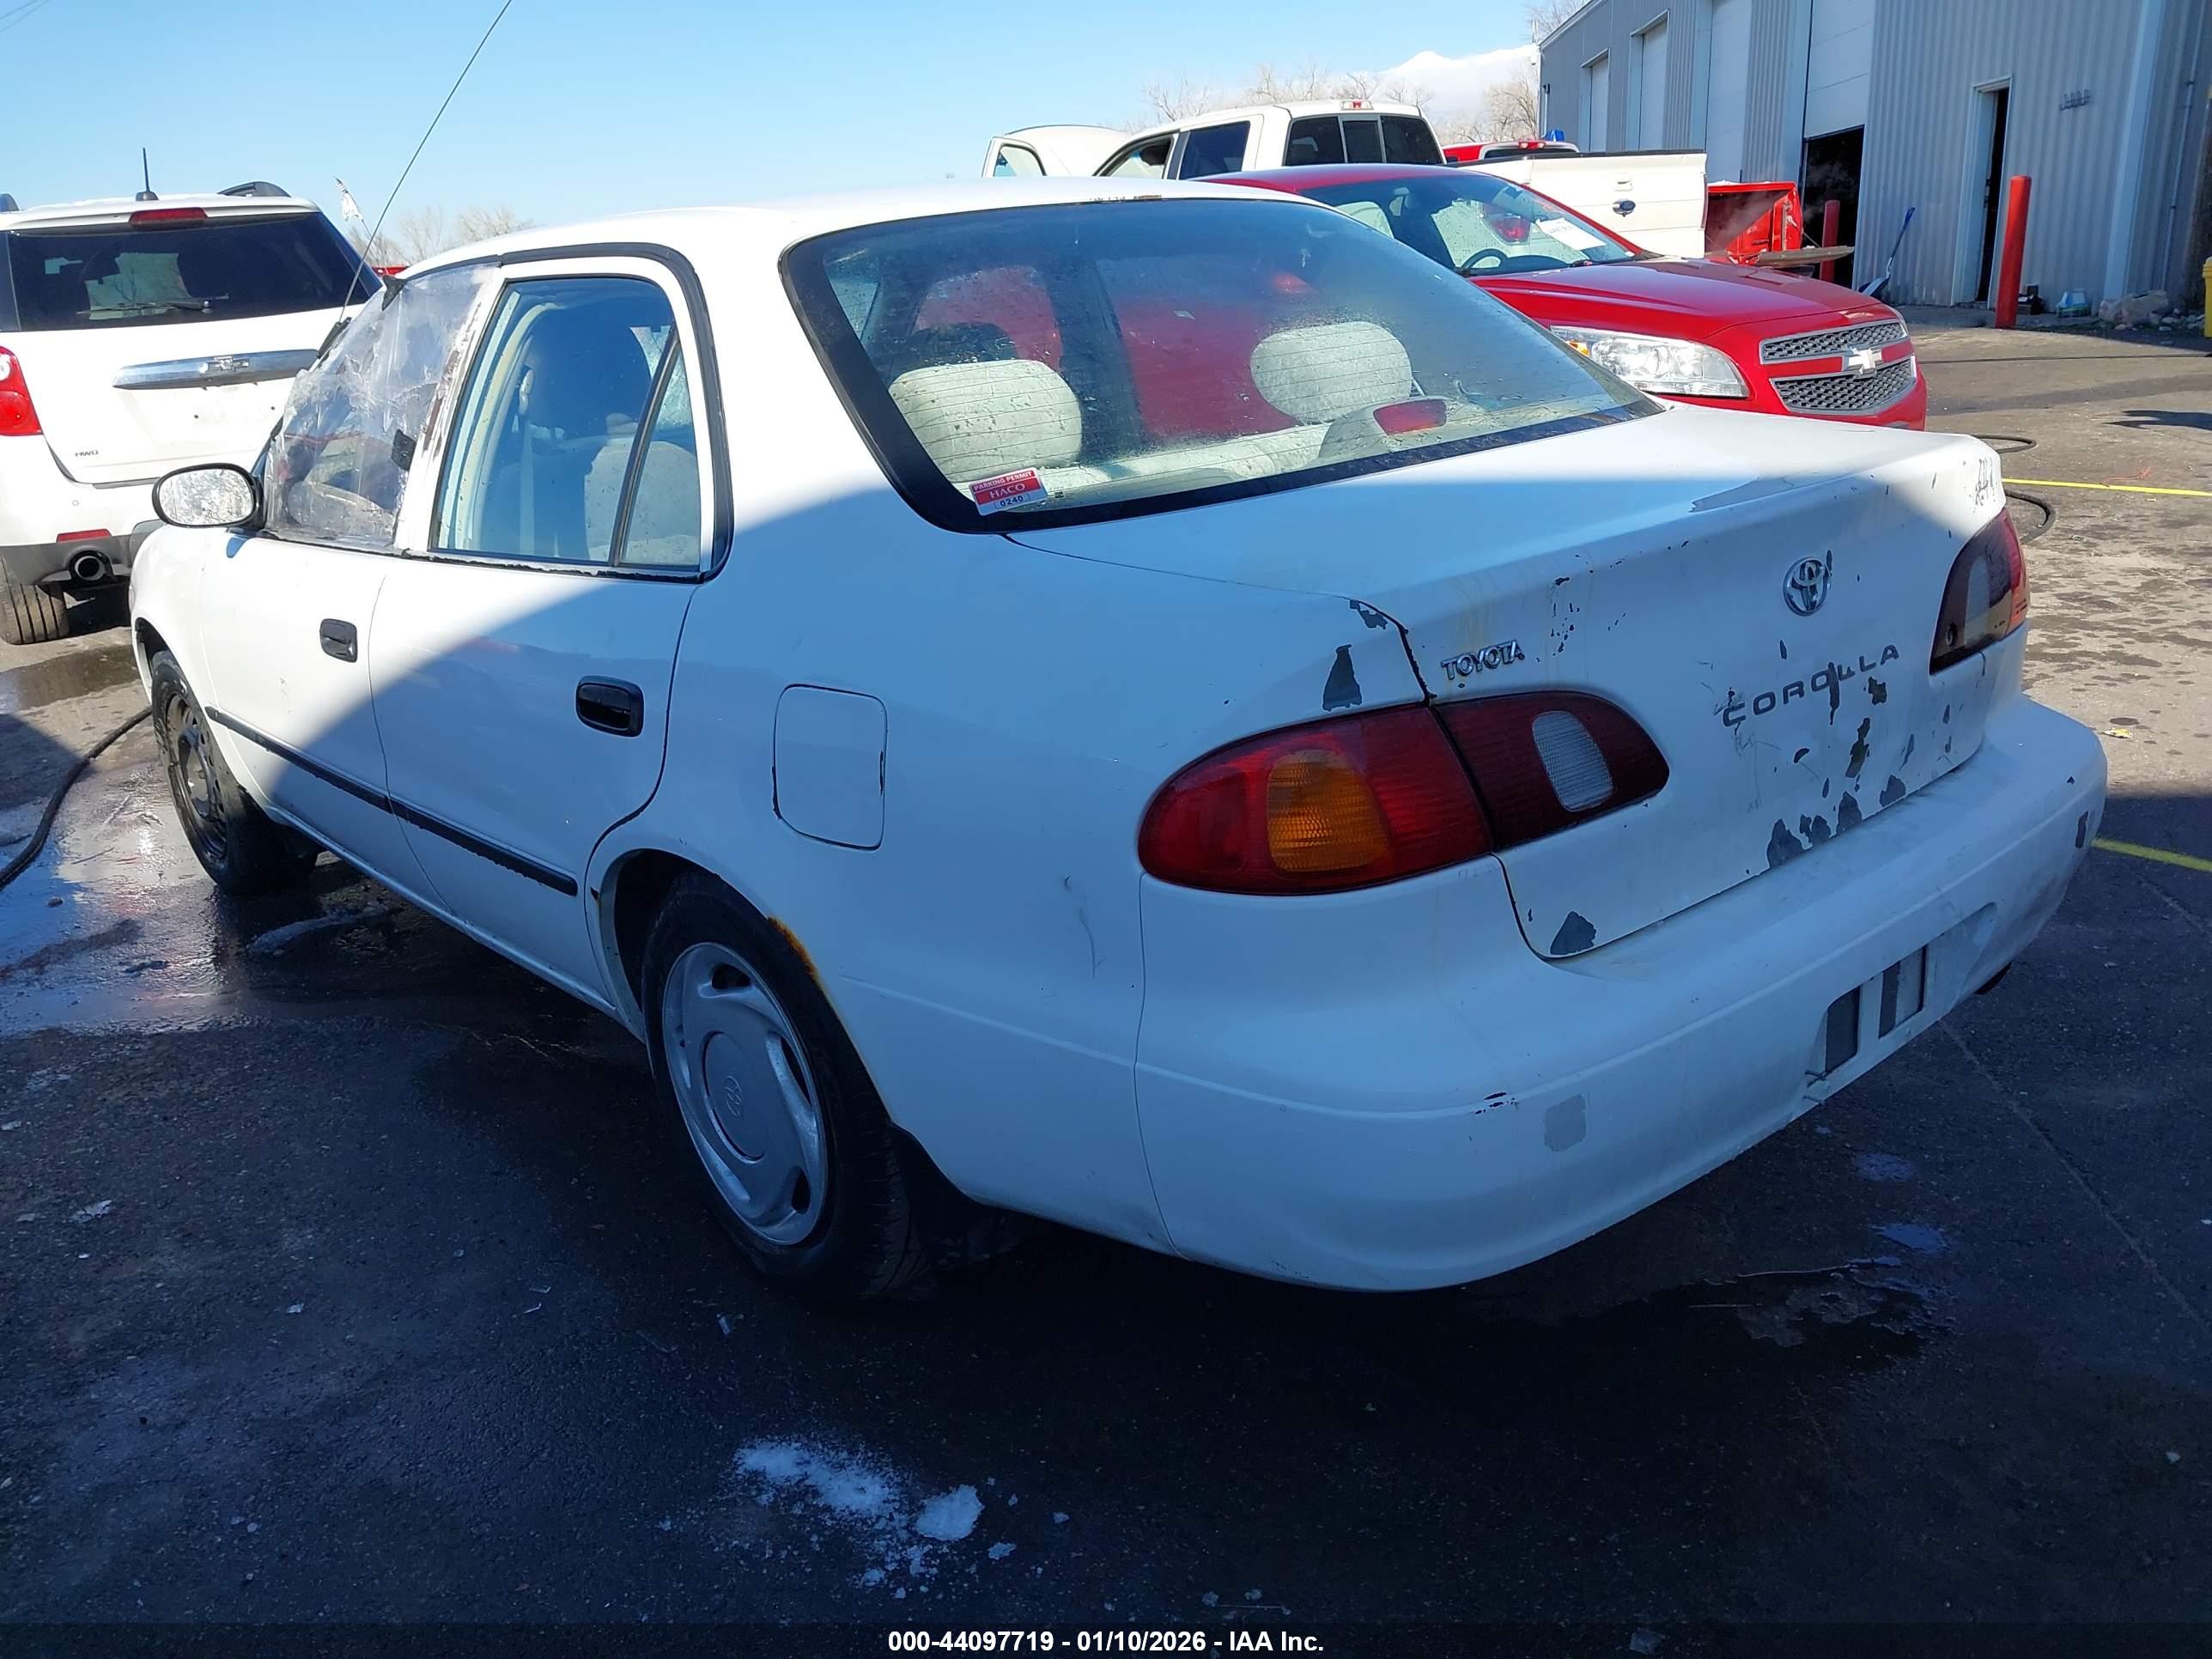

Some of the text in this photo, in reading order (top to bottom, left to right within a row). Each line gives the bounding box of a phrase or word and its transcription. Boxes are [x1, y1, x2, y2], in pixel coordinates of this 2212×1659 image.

[973, 471, 1033, 491] PARKING PERMIT
[989, 483, 1026, 499] HACO
[1000, 495, 1024, 507] 0240
[1441, 639, 1526, 681] TOYOTA
[1723, 644, 1900, 727] COROLLA
